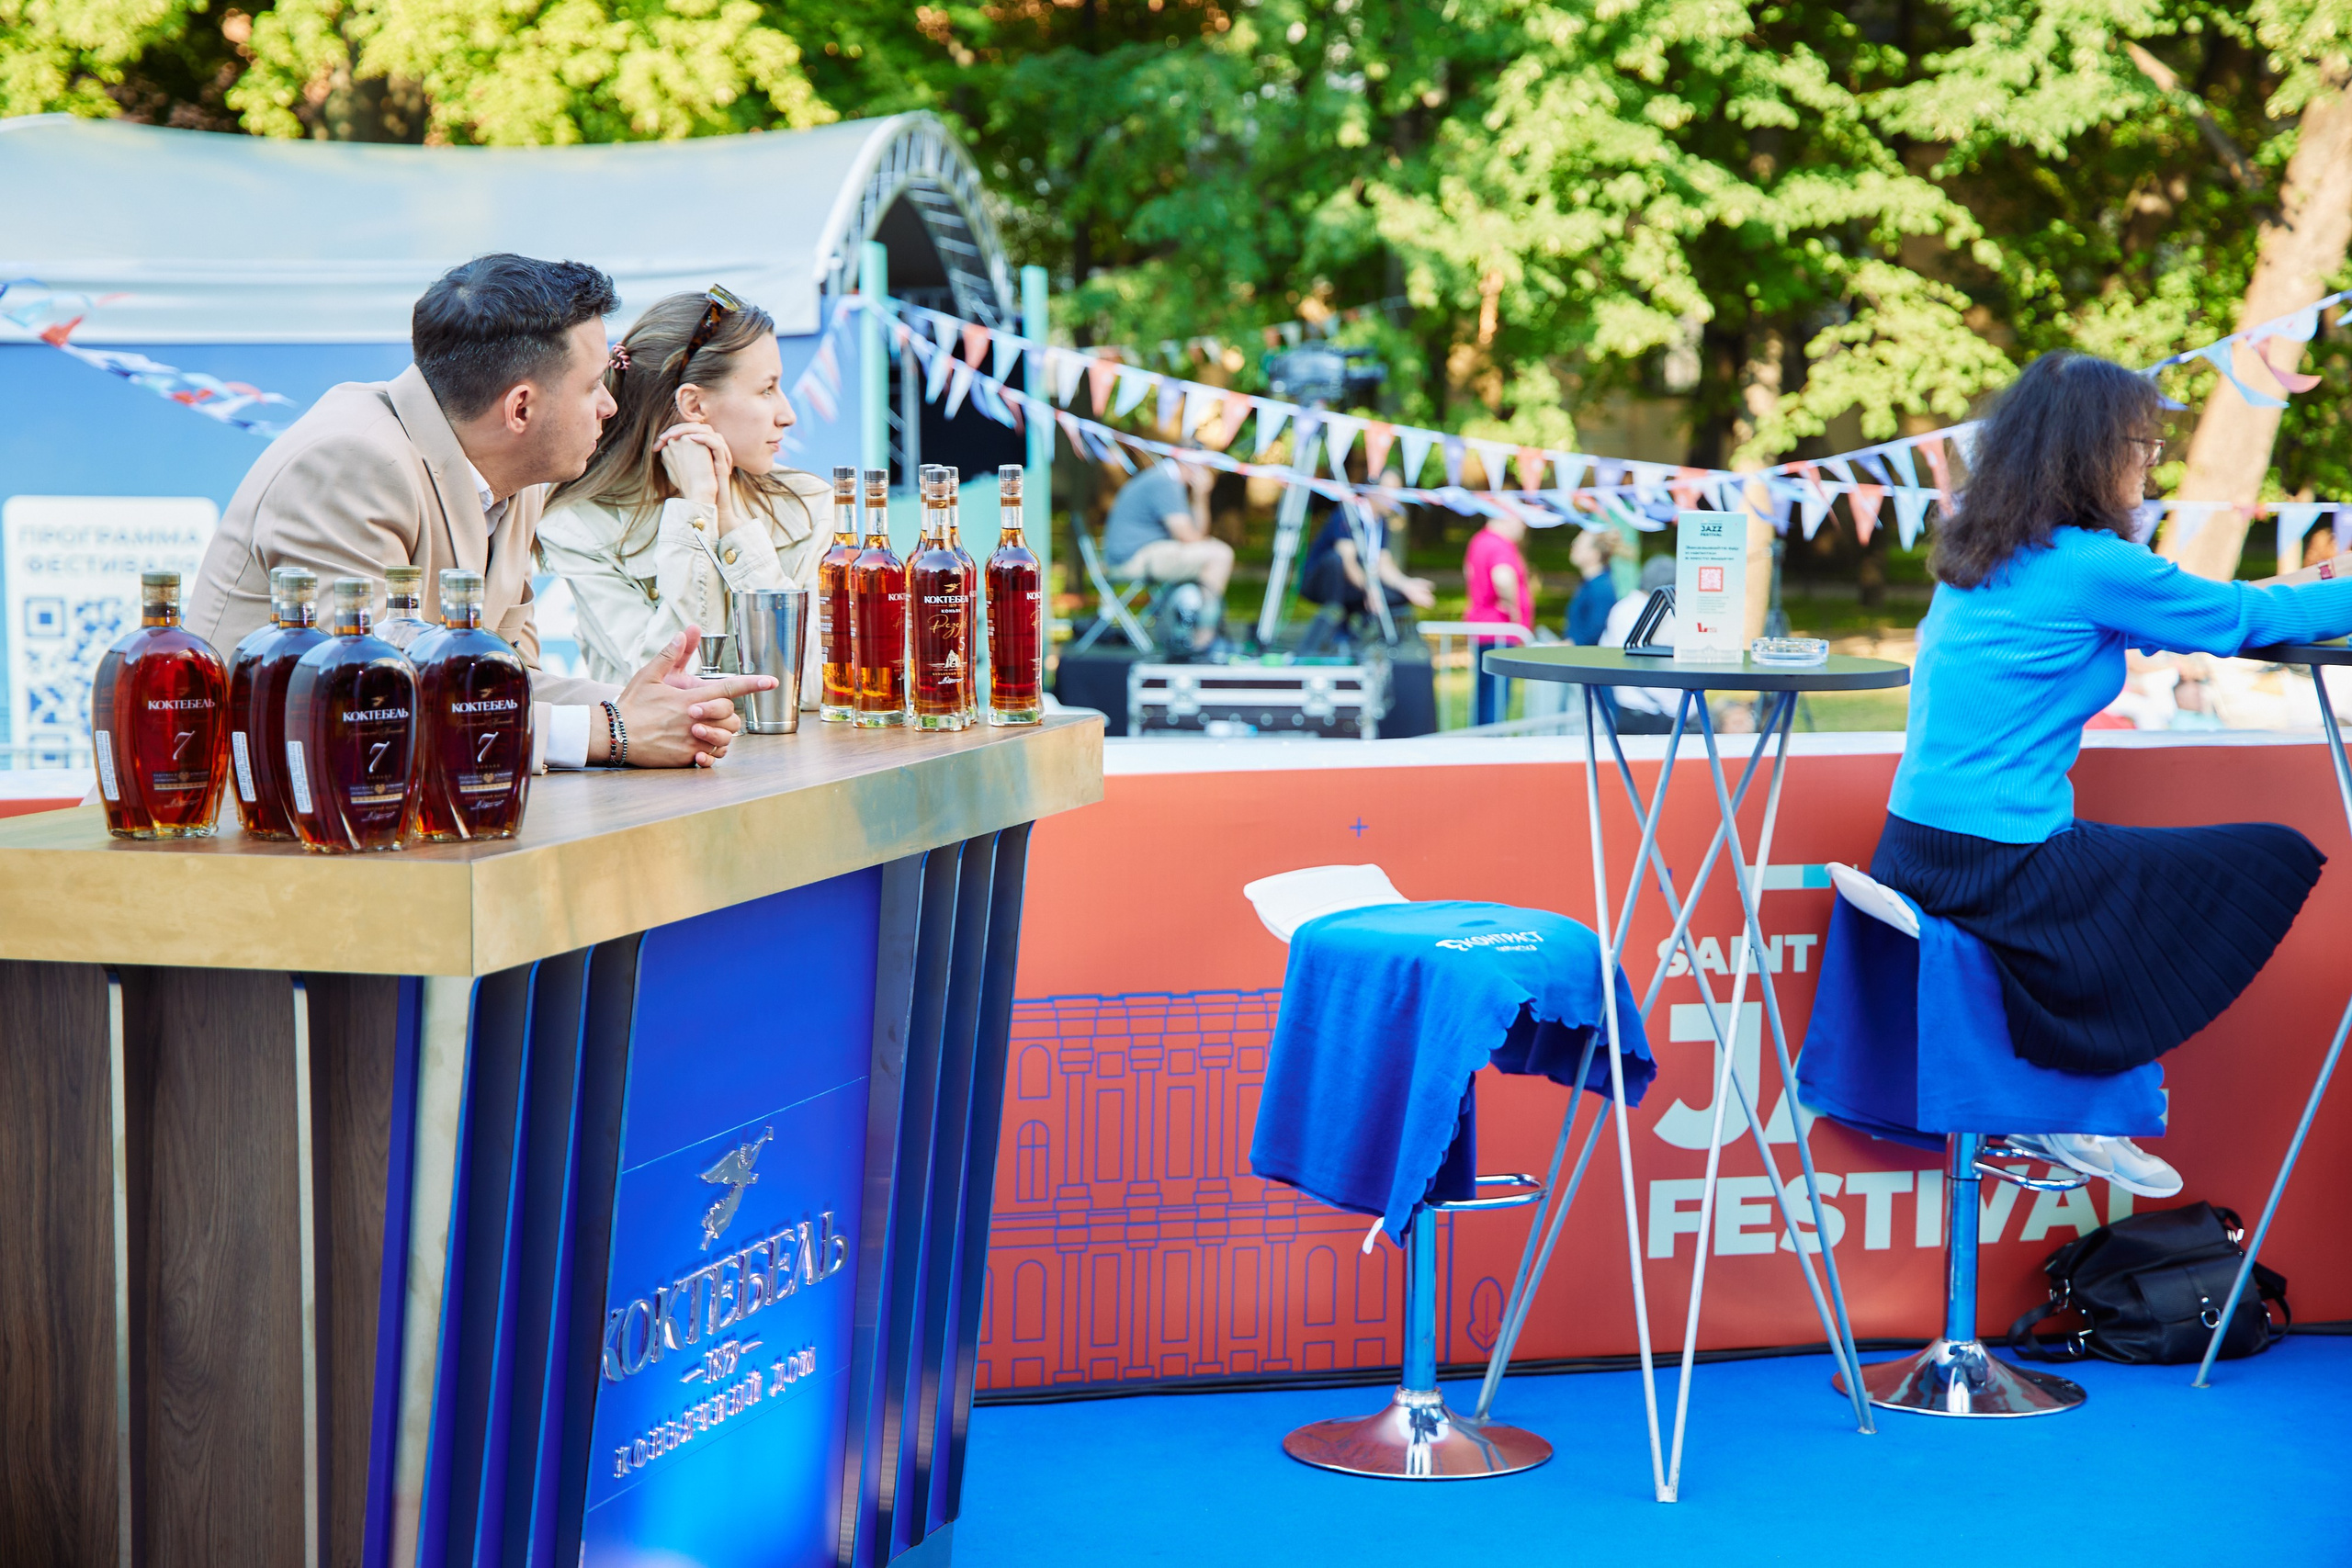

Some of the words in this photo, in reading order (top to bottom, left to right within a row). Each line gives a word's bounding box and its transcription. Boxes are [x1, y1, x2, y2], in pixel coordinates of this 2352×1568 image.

[18, 525, 201, 547] ПРОГРАММА
[148, 698, 215, 710] КОКТЕБЕЛЬ
[343, 707, 409, 722] КОКТЕБЕЛЬ
[452, 699, 518, 713] КОКТЕБЕЛЬ
[172, 730, 196, 761] 7
[368, 740, 390, 773] 7
[477, 731, 499, 762] 7
[1657, 933, 1818, 978] SAINT
[704, 1340, 741, 1383] 1879
[614, 1371, 763, 1478] КОНЬЯЧНЫЙ
[768, 1347, 816, 1397] ДОМ
